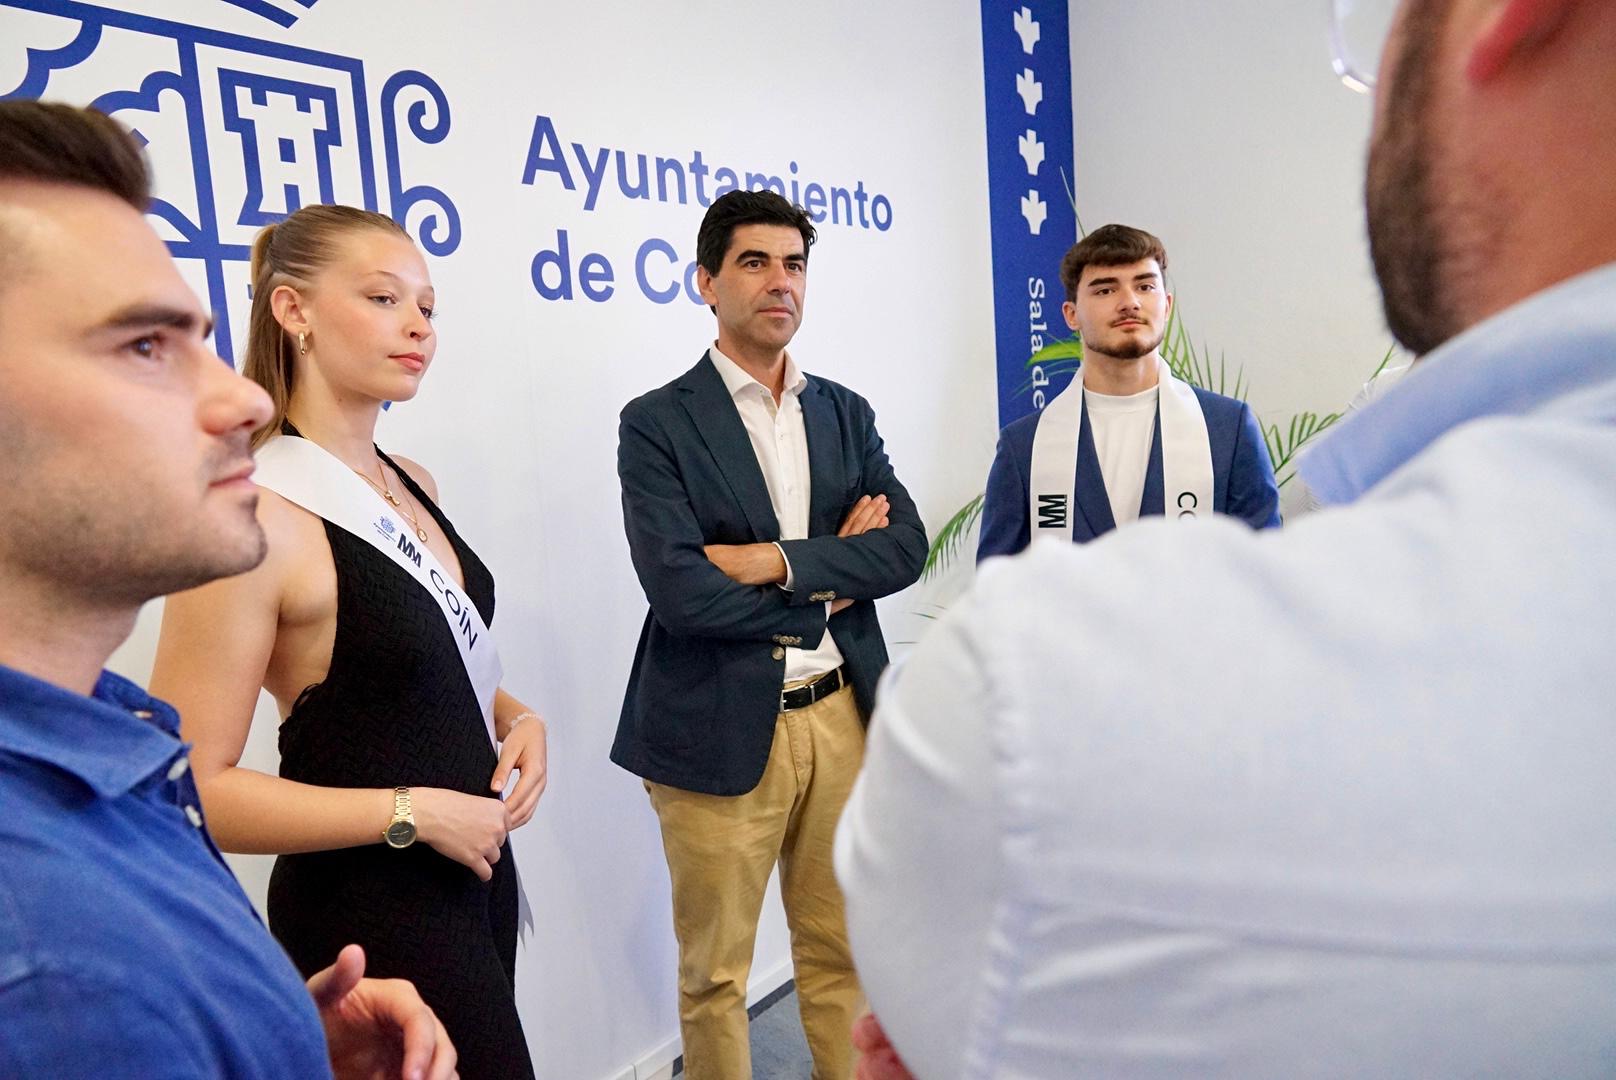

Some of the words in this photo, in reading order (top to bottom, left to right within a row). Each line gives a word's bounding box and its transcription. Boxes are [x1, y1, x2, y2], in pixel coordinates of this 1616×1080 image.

[531, 229, 615, 303] de
[1028, 277, 1048, 355] Sala
[1032, 365, 1050, 410] de
[429, 568, 479, 652] COÍN
